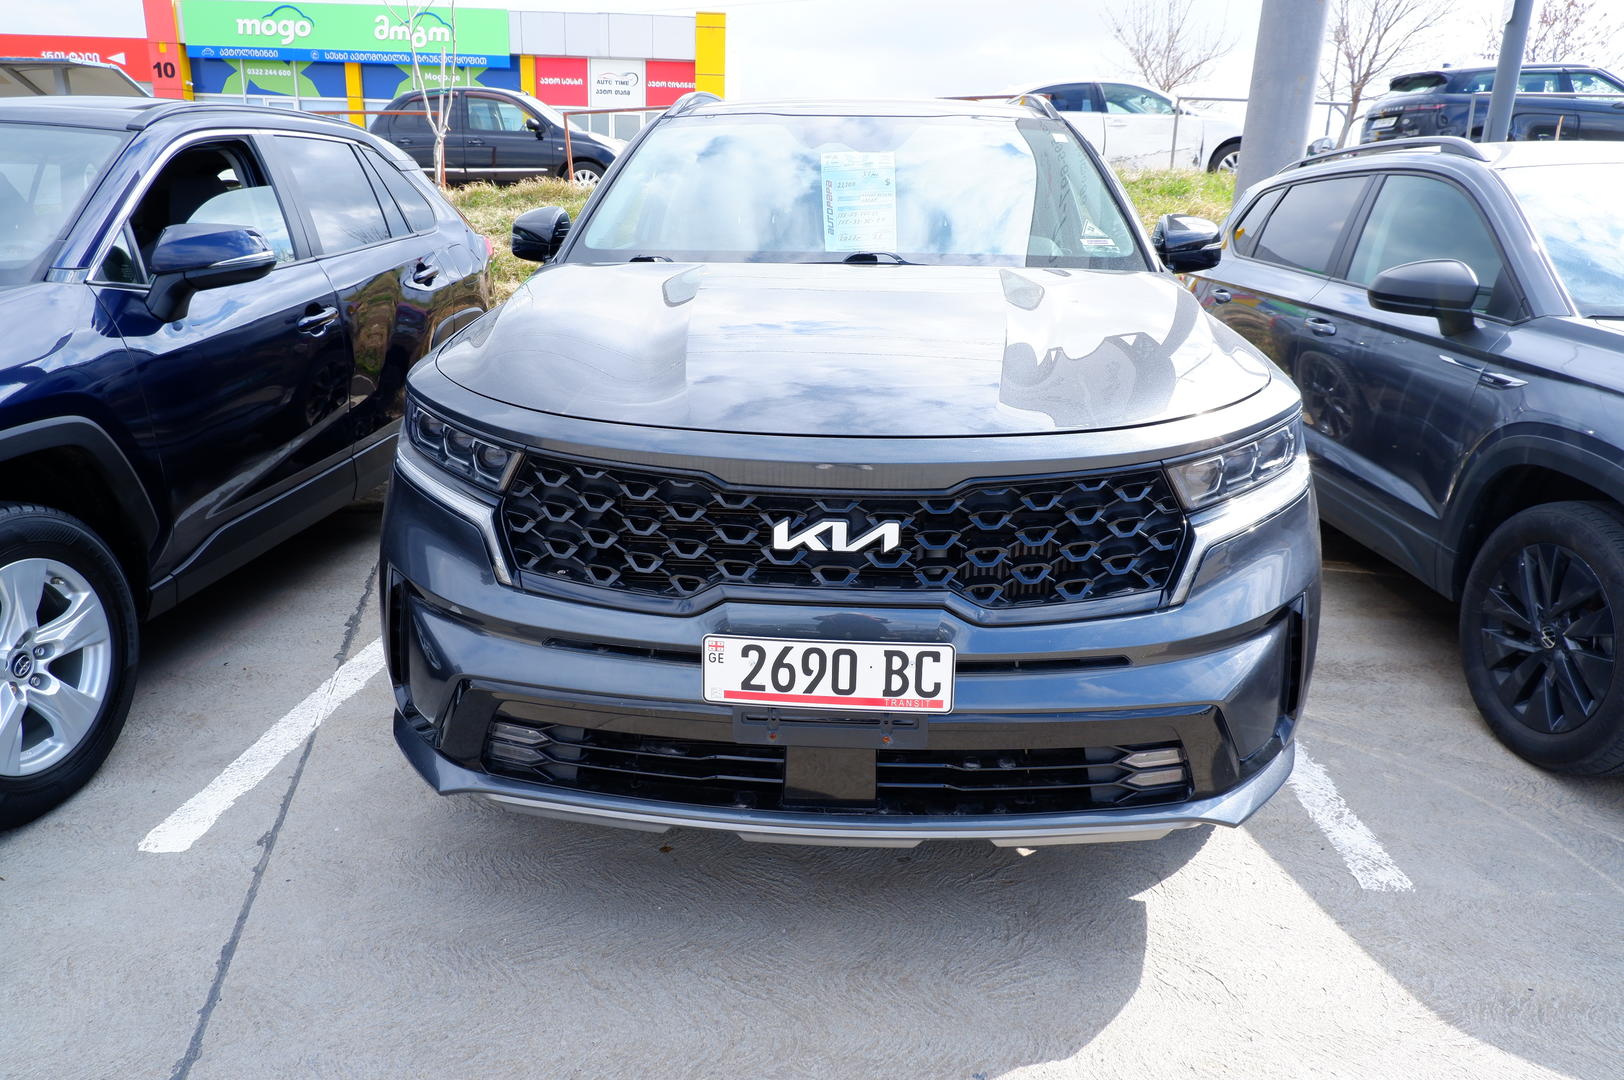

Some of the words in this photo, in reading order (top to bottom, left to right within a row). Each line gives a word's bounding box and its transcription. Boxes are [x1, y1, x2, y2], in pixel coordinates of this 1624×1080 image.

[236, 15, 312, 45] mogo
[373, 15, 450, 48] მოგო
[219, 48, 279, 58] ავტოლიზინგი
[324, 51, 349, 60] სესხი
[350, 52, 411, 62] ავტომობილის
[153, 61, 175, 79] 10
[539, 77, 561, 85] ავტო
[773, 519, 900, 553] KIA
[708, 652, 724, 664] GE
[740, 644, 858, 696] 2690
[882, 649, 942, 699] BC
[884, 698, 930, 708] TRANSIT
